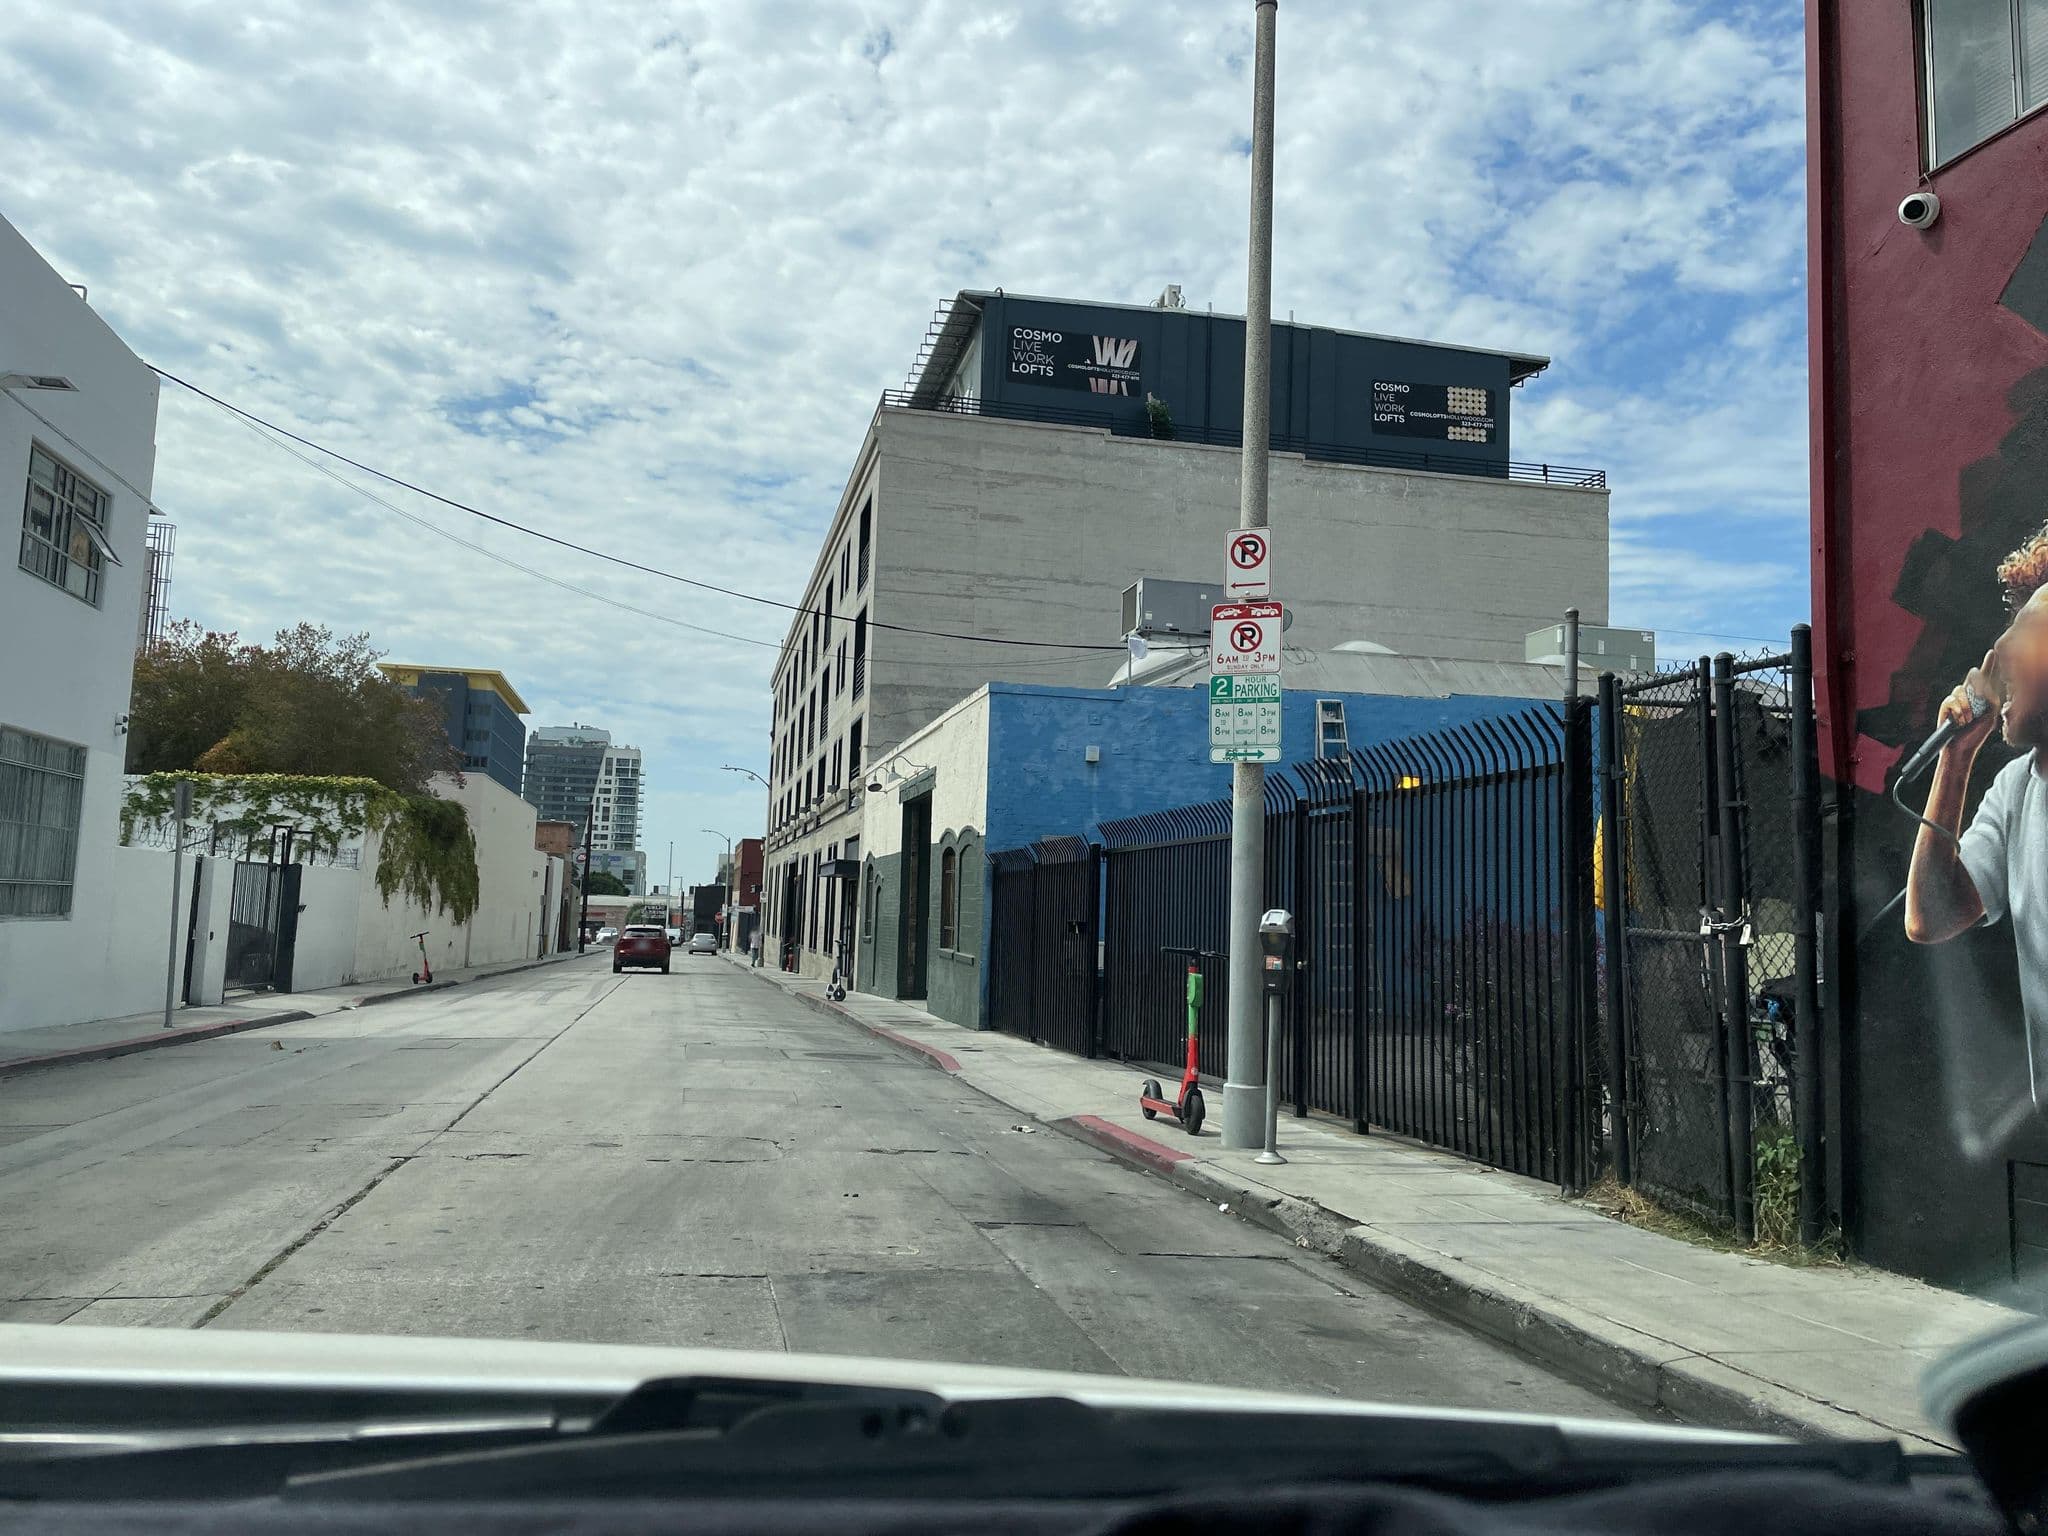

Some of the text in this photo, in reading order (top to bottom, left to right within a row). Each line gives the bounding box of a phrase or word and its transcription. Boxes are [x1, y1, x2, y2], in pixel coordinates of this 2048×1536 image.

[1013, 328, 1062, 343] COSMO
[1013, 339, 1041, 352] LIVE
[1013, 350, 1054, 365] WORK
[1012, 362, 1054, 377] LOFTS
[1374, 382, 1410, 393] COSMO
[1374, 392, 1395, 402] LIVE
[1374, 403, 1405, 413] WORK
[1374, 413, 1405, 423] LOFTS
[1244, 676, 1267, 684] HOUR
[1215, 678, 1228, 696] 2
[1234, 683, 1277, 697] PARKING
